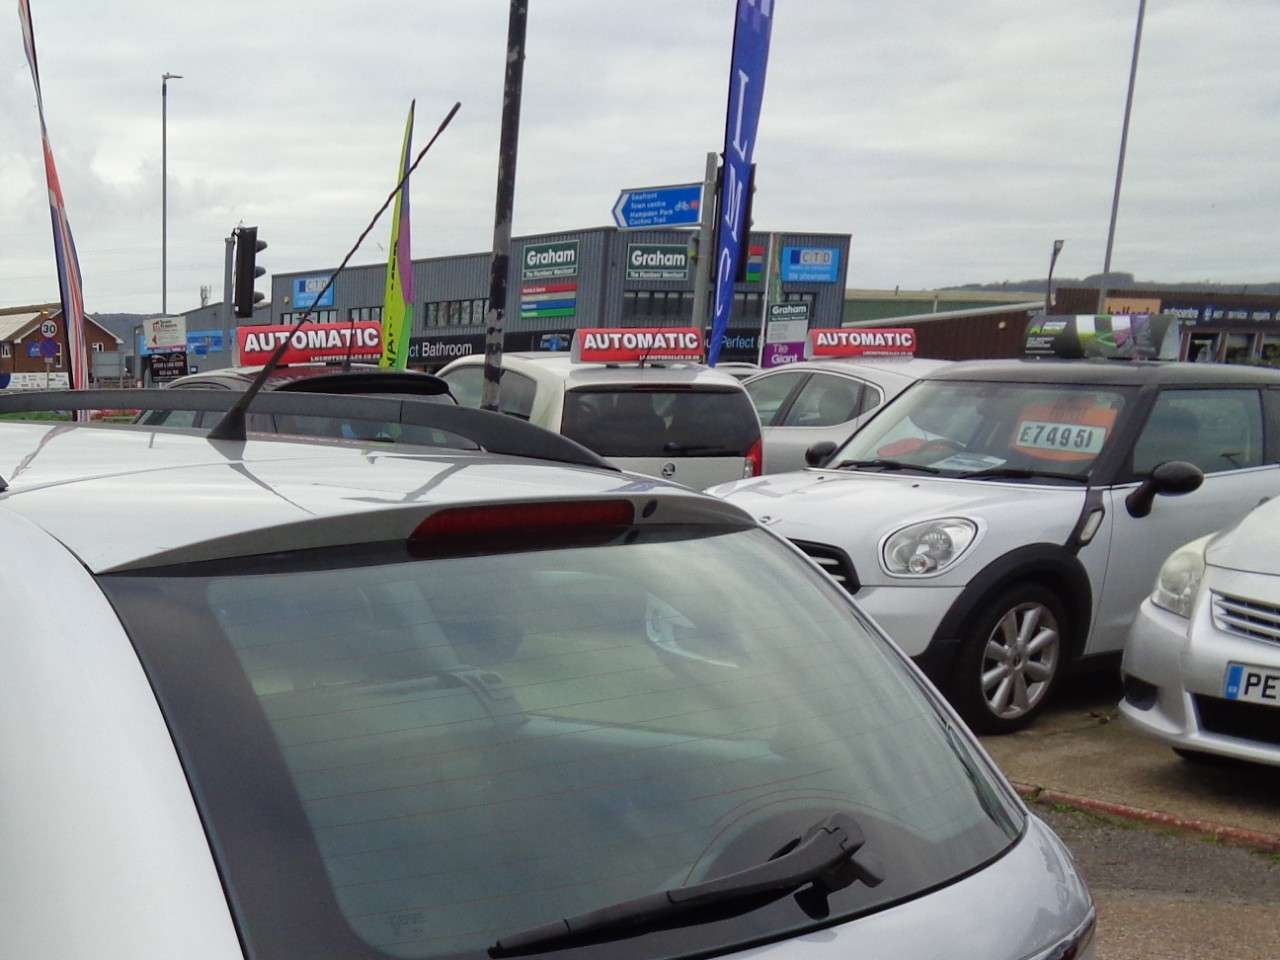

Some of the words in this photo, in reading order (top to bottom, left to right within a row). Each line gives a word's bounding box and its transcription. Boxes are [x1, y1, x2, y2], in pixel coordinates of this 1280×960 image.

[527, 248, 575, 266] Graham
[631, 249, 686, 266] Graham
[772, 304, 807, 314] Graham
[43, 324, 56, 334] 30
[244, 327, 380, 353] AUTOMATIC
[584, 333, 699, 349] AUTOMATIC
[721, 335, 754, 349] Perfect
[817, 332, 914, 347] AUTOMATIC
[422, 342, 472, 357] Bathroom
